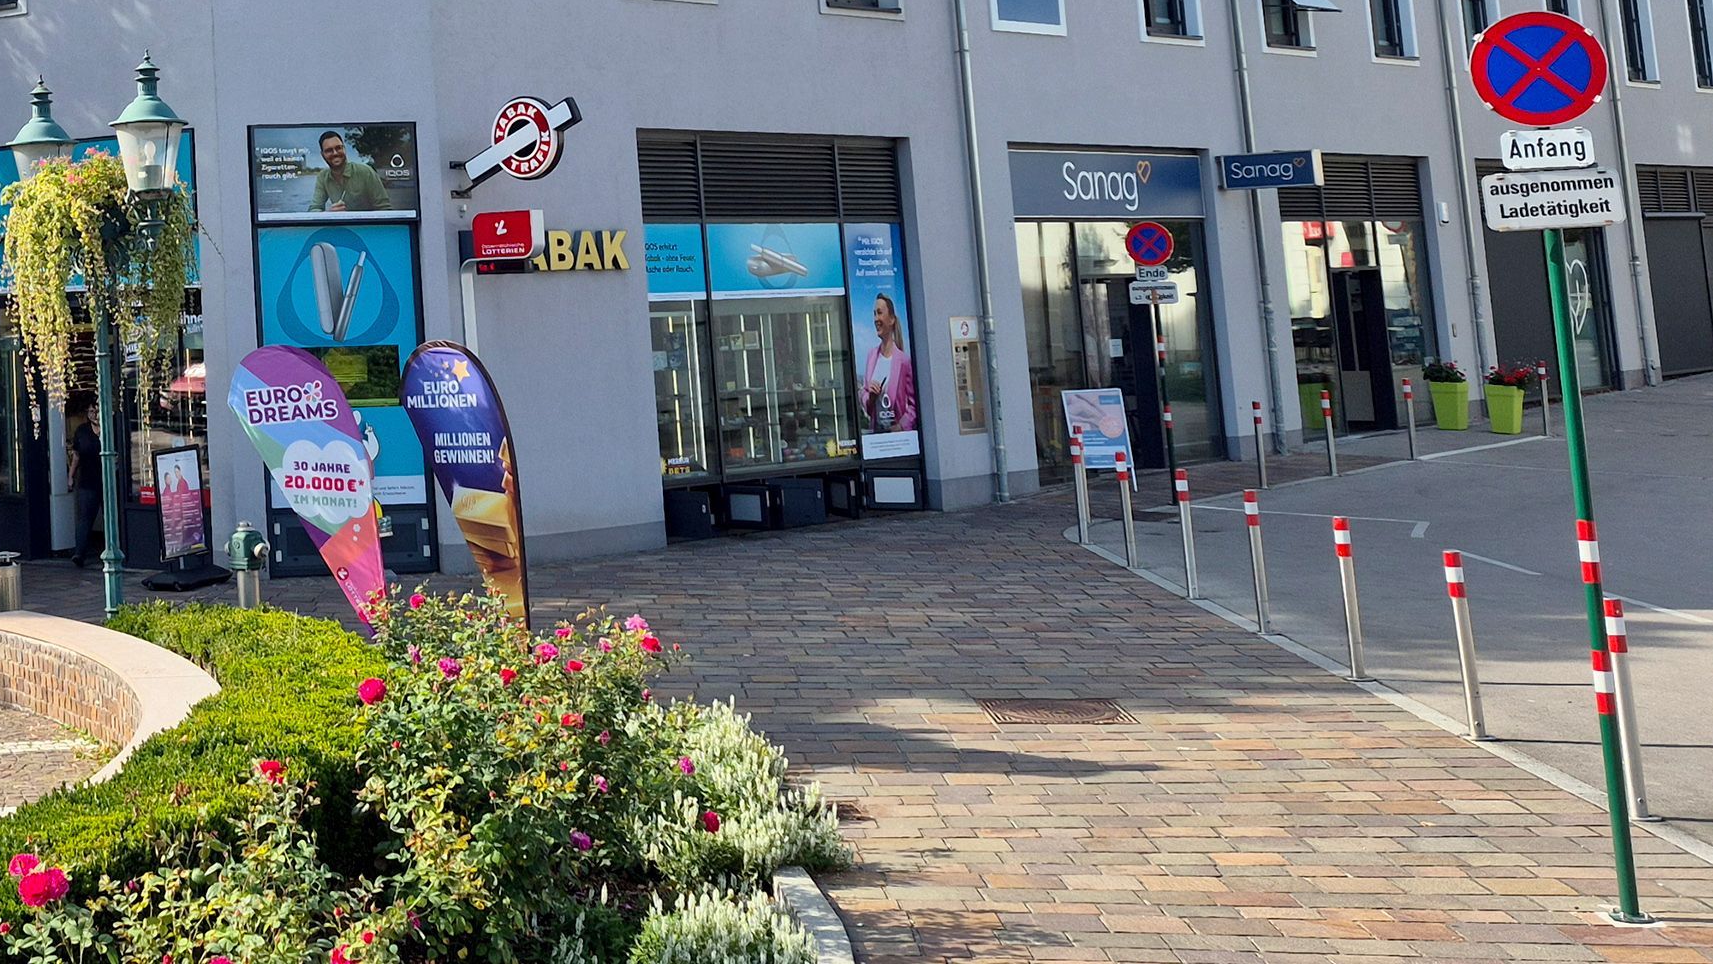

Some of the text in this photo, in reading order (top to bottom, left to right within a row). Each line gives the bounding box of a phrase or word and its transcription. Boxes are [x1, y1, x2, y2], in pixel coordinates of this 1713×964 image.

[495, 103, 538, 138] TABAK
[509, 131, 550, 173] TRAFIK
[1509, 138, 1586, 162] Anfang
[385, 169, 411, 177] IQOS
[1230, 161, 1294, 181] Sanag
[1062, 160, 1139, 211] Sanag
[1490, 176, 1615, 198] ausgenommen
[1499, 197, 1612, 220] Ladetätigkeit
[1139, 268, 1166, 278] Ende
[245, 387, 303, 407] EURO
[423, 380, 460, 395] EURO
[407, 394, 477, 408] MILLIONEN
[248, 401, 337, 424] DREAMS
[434, 432, 491, 447] MILLIONEN
[434, 449, 495, 464] GEWINNEN!
[293, 461, 351, 474] 30 JAHRE
[293, 495, 358, 508] IM MONAT!
